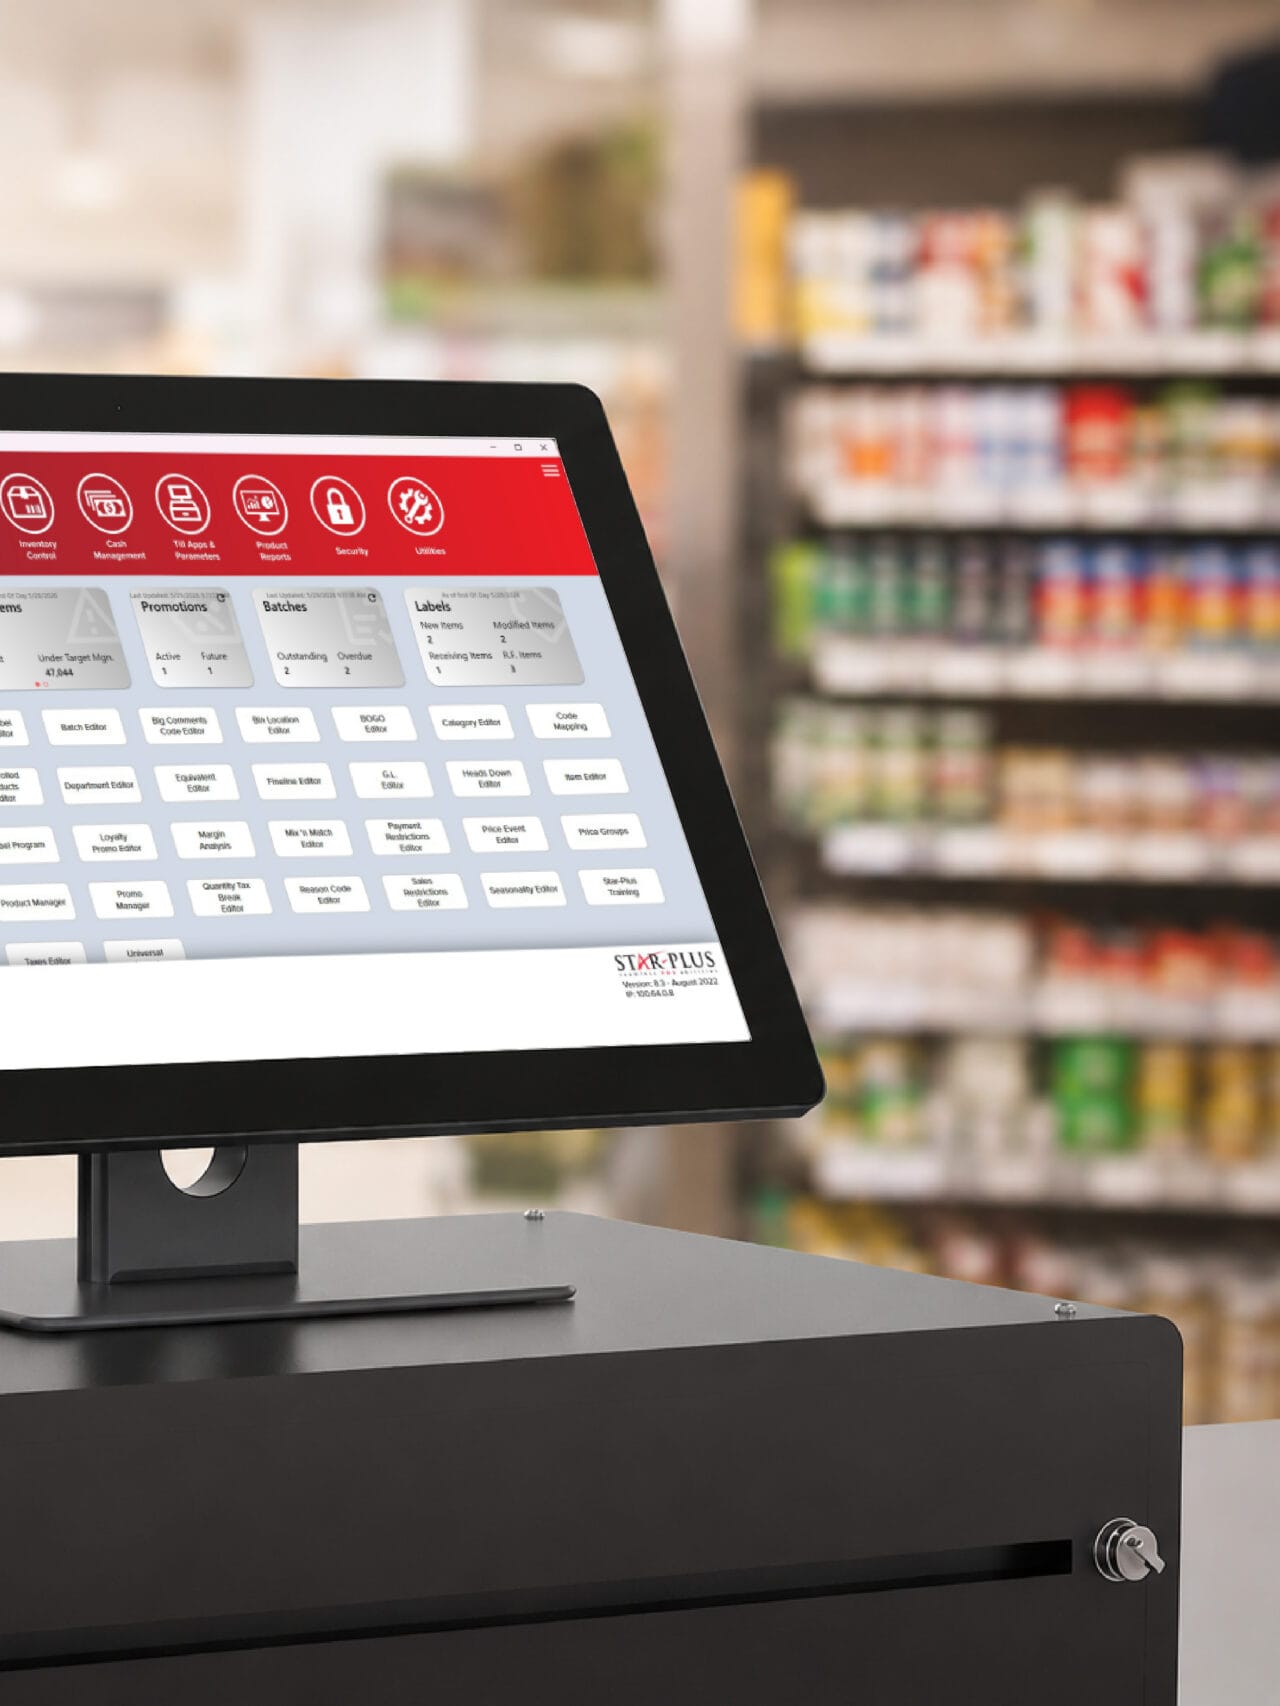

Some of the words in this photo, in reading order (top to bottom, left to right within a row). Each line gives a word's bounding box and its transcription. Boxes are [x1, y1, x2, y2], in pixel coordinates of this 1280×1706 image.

[19, 540, 57, 550] Inventory
[106, 540, 127, 548] Cash
[187, 540, 208, 550] Apps
[256, 542, 288, 550] Product
[335, 547, 368, 556] Security
[415, 547, 446, 555] Utilities
[26, 552, 56, 560] Control
[94, 552, 146, 560] Management
[175, 552, 220, 560] Parameters
[260, 553, 292, 561] Reports
[141, 601, 208, 612] Promotions
[263, 601, 307, 612] Batches
[415, 600, 451, 612] Labels
[441, 622, 464, 630] Items
[493, 621, 530, 629] Modified
[532, 621, 555, 629] Items
[39, 654, 62, 662] Under
[64, 654, 91, 663] Target
[156, 652, 181, 661] Active
[201, 652, 227, 661] Future
[277, 652, 328, 662] Outstanding
[337, 652, 372, 660] Overdue
[429, 652, 468, 661] Receiving
[470, 652, 493, 660] Items
[519, 651, 542, 659] Items
[152, 717, 165, 726] Big
[167, 717, 207, 725] Comments
[267, 716, 299, 724] Location
[360, 715, 385, 723] BOGO
[61, 723, 83, 731] Batch
[85, 723, 107, 731] Editor
[442, 719, 477, 728] Category
[554, 723, 587, 731] Mapping
[183, 727, 205, 735] Editor
[365, 725, 387, 733] Editor
[175, 773, 216, 783] Equivalent
[565, 773, 582, 781] Item
[584, 773, 606, 781] Editor
[64, 782, 110, 792] Department
[111, 781, 134, 789] Editor
[478, 780, 501, 788] Editor
[388, 822, 422, 832] Payment
[482, 826, 502, 834] Price
[503, 824, 526, 832] Event
[198, 831, 226, 839] Margin
[578, 828, 598, 836] Price
[600, 828, 629, 836] Groups
[100, 833, 127, 842] Loyalty
[496, 836, 518, 844] Editor
[12, 841, 45, 850] Program
[92, 845, 117, 853] Promo
[200, 842, 232, 851] Analysis
[400, 844, 422, 852] Editor
[411, 878, 432, 886] Sales
[202, 882, 235, 891] Quantity
[331, 885, 351, 893] Code
[489, 886, 534, 895] Seasonality
[117, 890, 143, 898] Promo
[404, 888, 448, 896] Restrictions
[608, 888, 639, 898] Training
[1, 899, 31, 907] Product
[32, 899, 66, 908] Manager
[116, 902, 149, 911] Manager
[221, 905, 244, 913] Editor
[126, 949, 164, 957] Universal
